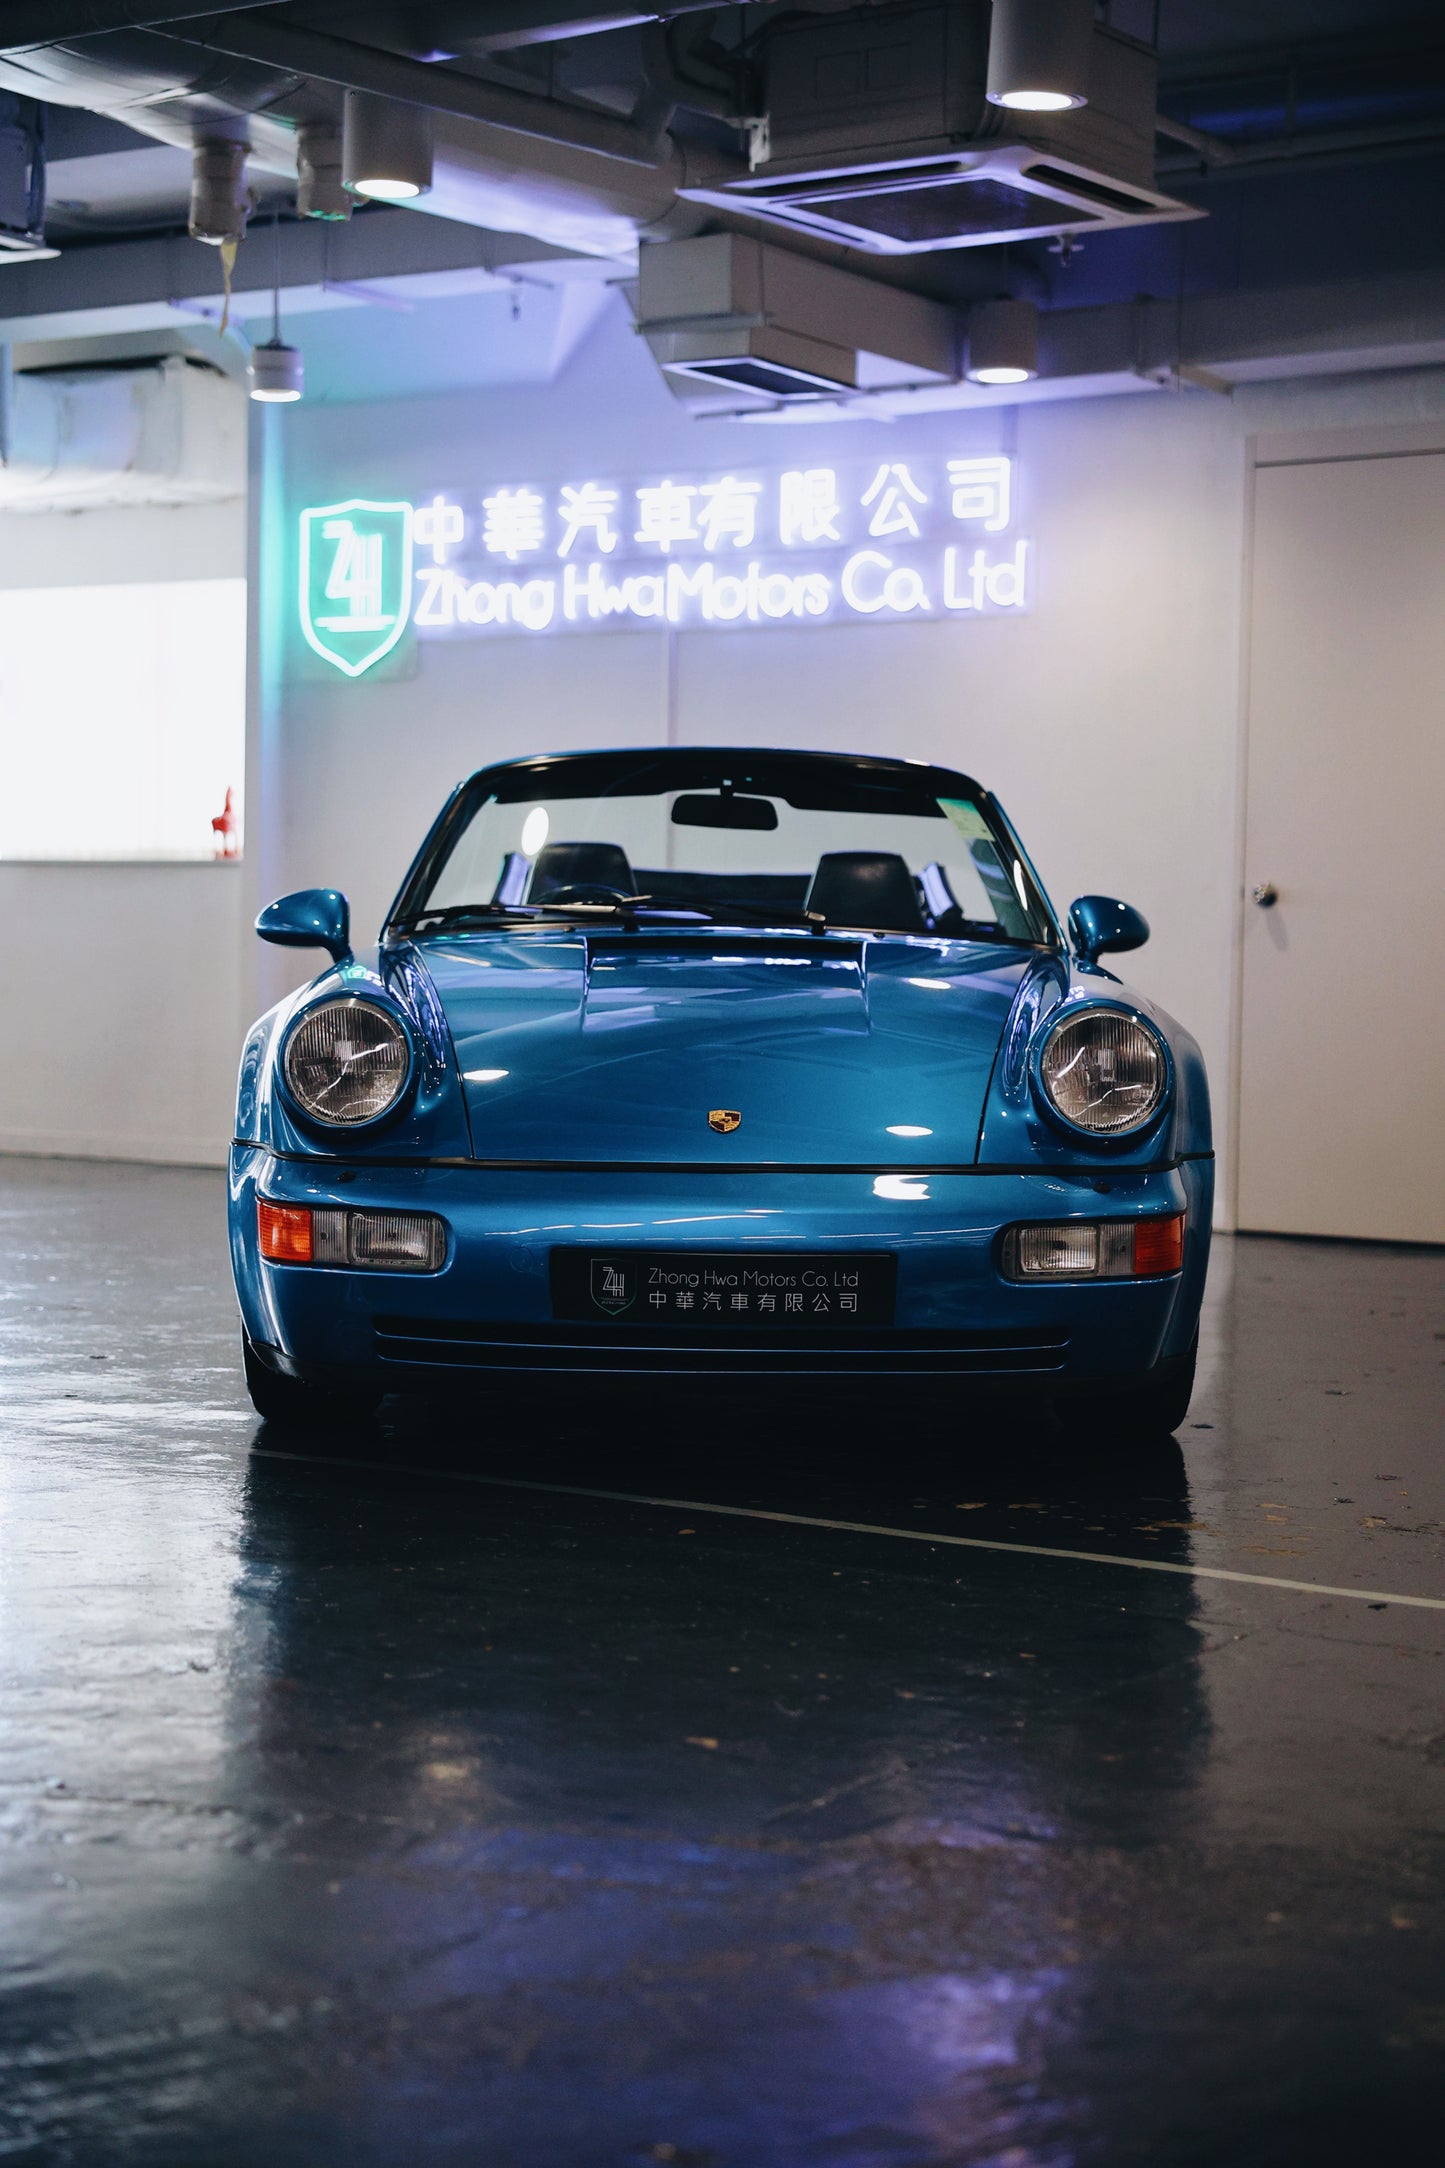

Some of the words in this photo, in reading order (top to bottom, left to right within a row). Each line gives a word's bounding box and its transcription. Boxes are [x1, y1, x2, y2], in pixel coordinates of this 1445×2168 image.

[414, 457, 1012, 565] 中華汽車有限公司
[413, 567, 555, 631] Zhong
[563, 562, 664, 620] Hwa
[666, 562, 832, 622] Motors
[943, 540, 1027, 611] Ltd
[648, 1267, 700, 1288] Zhong
[704, 1269, 738, 1286] Hwa
[743, 1270, 797, 1287] Motors
[801, 1270, 829, 1287] Co.
[834, 1271, 859, 1287] Ltd
[649, 1290, 858, 1313] 中華汽車有限公司
